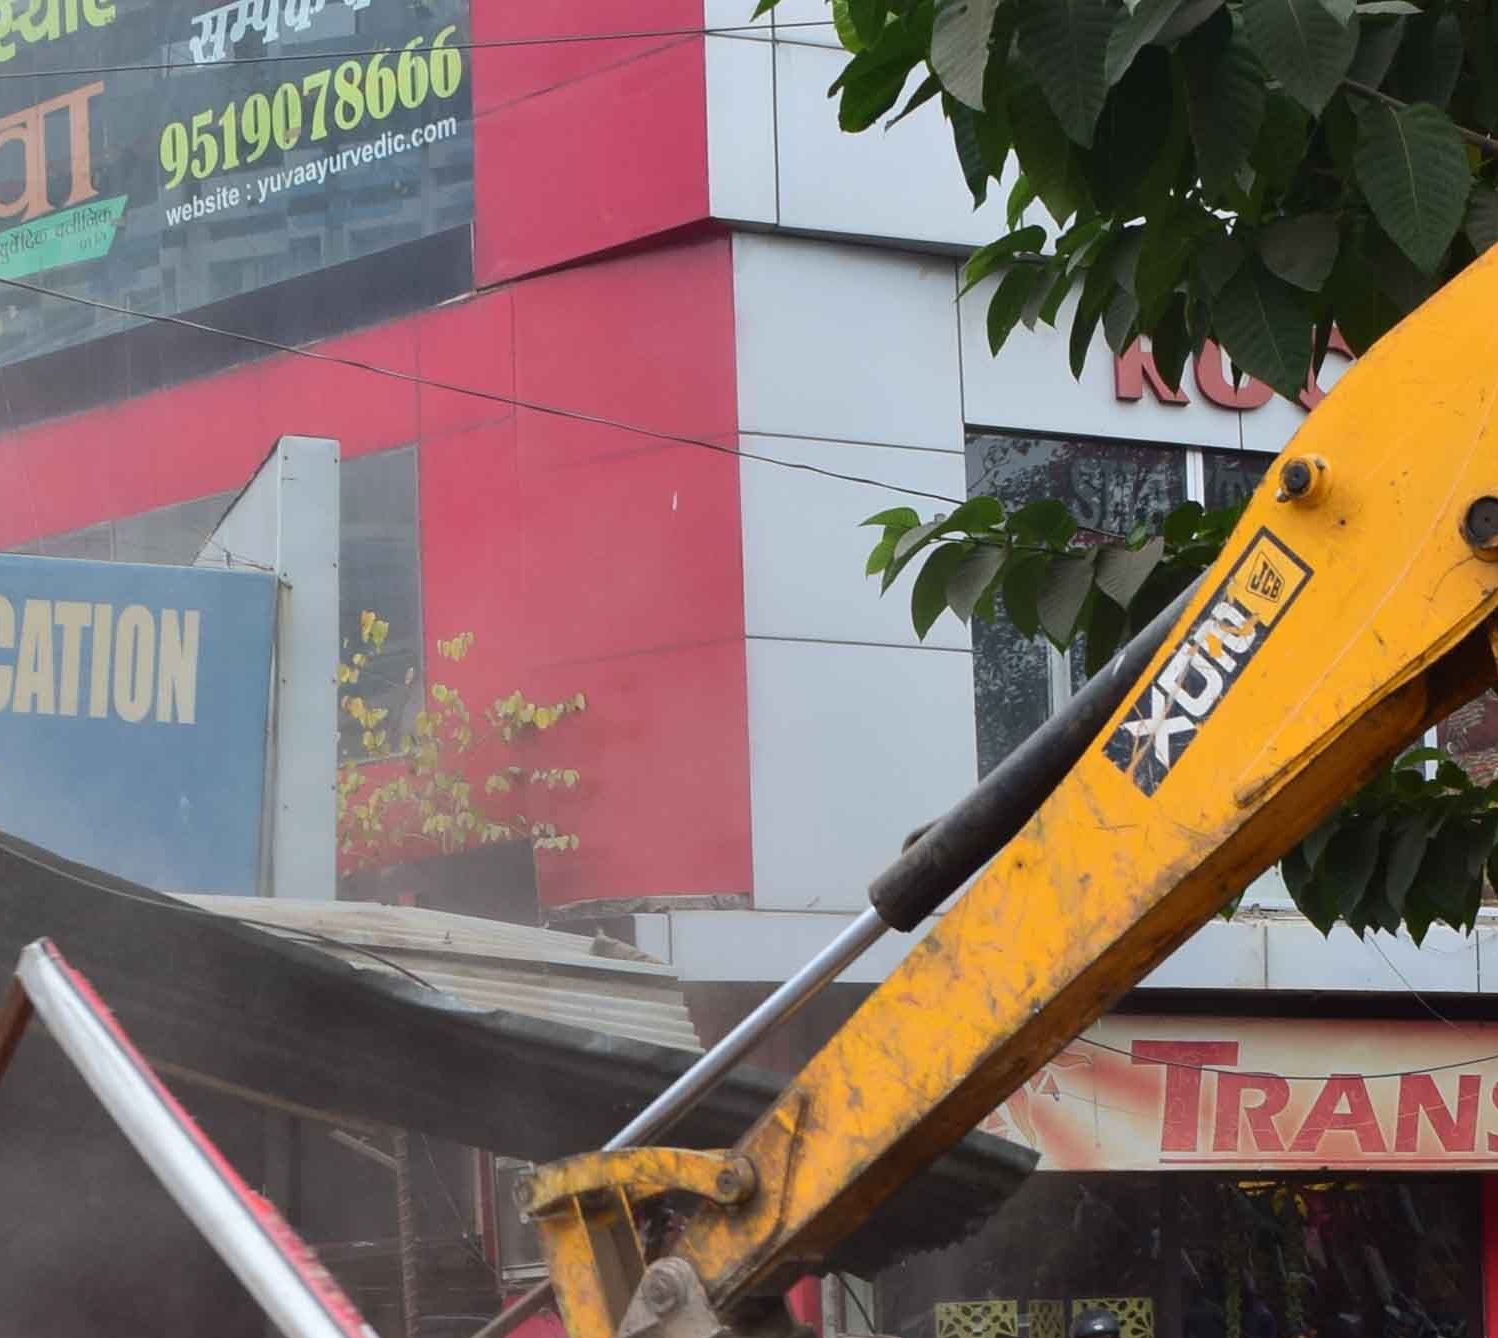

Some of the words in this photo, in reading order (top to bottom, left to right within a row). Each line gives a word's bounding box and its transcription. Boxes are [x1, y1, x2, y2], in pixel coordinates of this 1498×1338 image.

[160, 25, 462, 190] 9519078666
[166, 186, 239, 226] website
[257, 116, 457, 203] yuvaayurvedic.com
[1250, 560, 1283, 599] JCB
